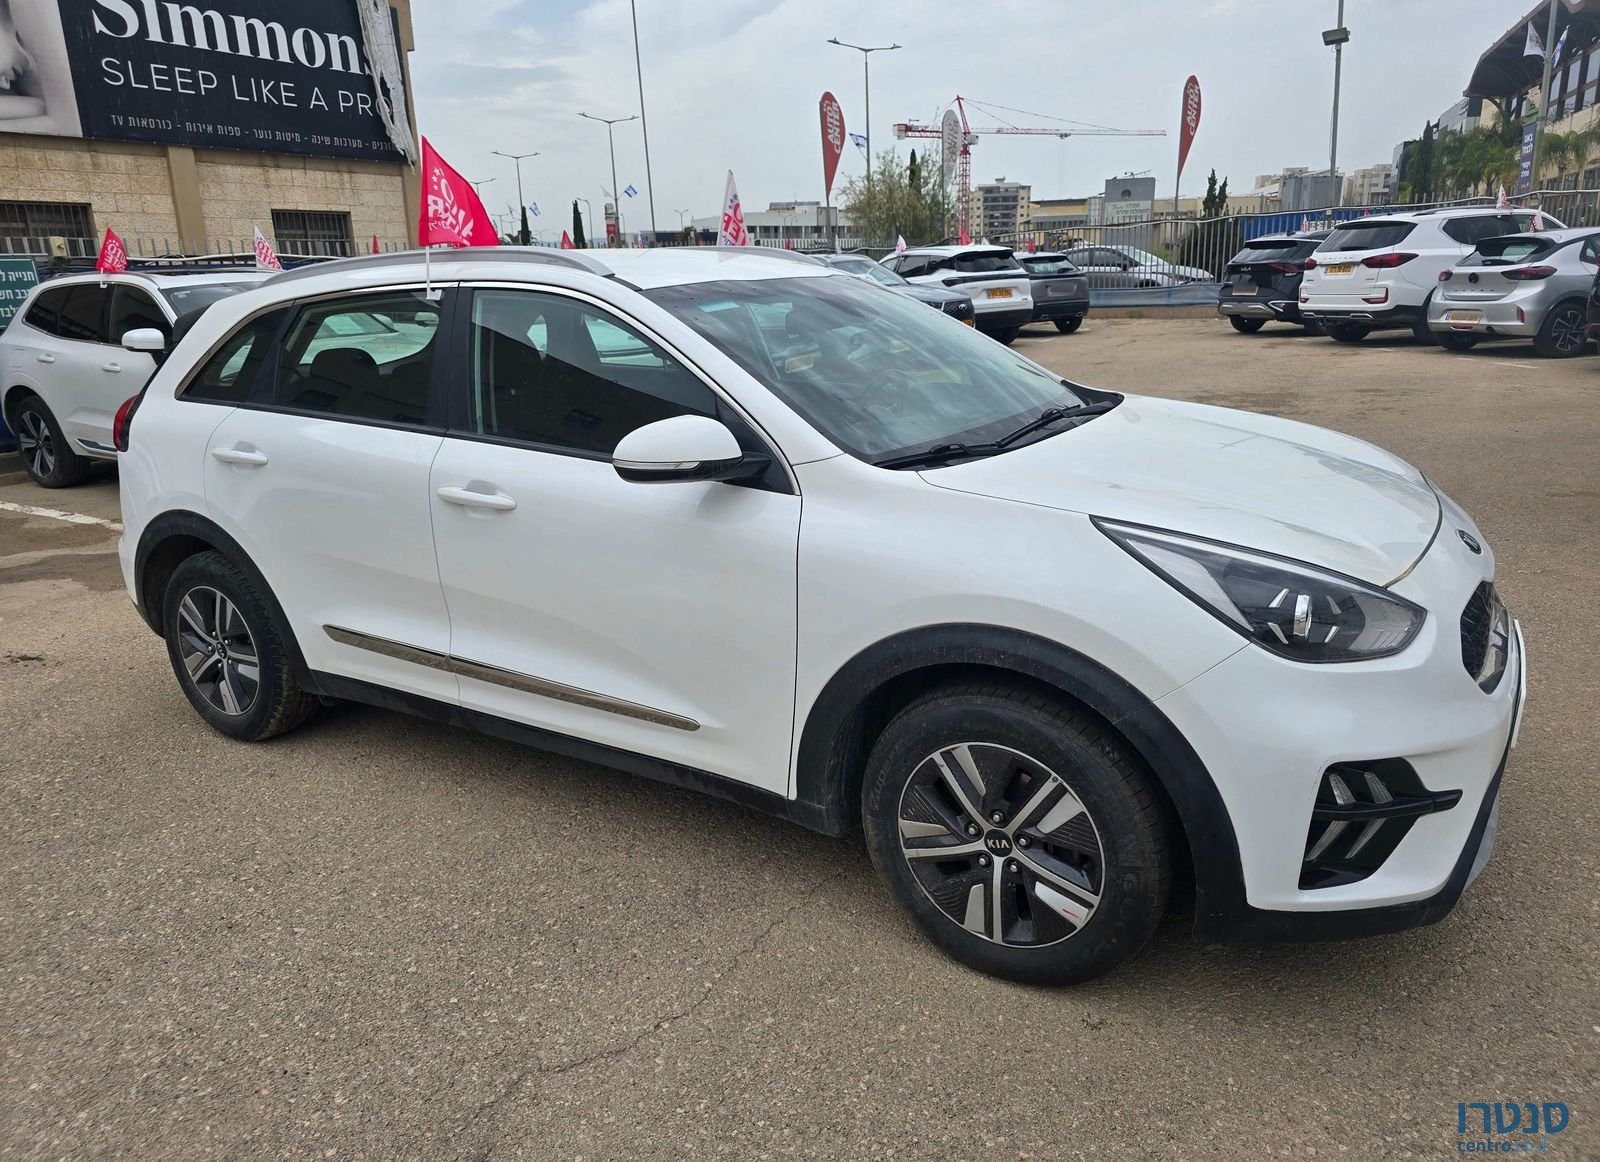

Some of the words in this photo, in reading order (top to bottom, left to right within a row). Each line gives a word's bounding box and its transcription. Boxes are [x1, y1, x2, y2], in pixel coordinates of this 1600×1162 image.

[92, 0, 373, 76] Simmon
[101, 57, 218, 96] SLEEP
[231, 74, 298, 108] LIKE
[309, 86, 329, 111] A
[1186, 89, 1195, 126] AUTO
[1189, 84, 1200, 137] CENTER
[111, 114, 123, 126] TV
[128, 116, 172, 130] כורסאות
[826, 106, 835, 145] AUTO
[186, 121, 214, 134] אירוח
[217, 125, 241, 137] ספות
[253, 128, 273, 140] נוער
[832, 101, 841, 154] CENTER
[275, 131, 301, 142] מיטות
[311, 134, 331, 145] שינה
[7, 271, 35, 282] חנייה
[0, 305, 18, 318] לבד
[986, 838, 1010, 849] KIA
